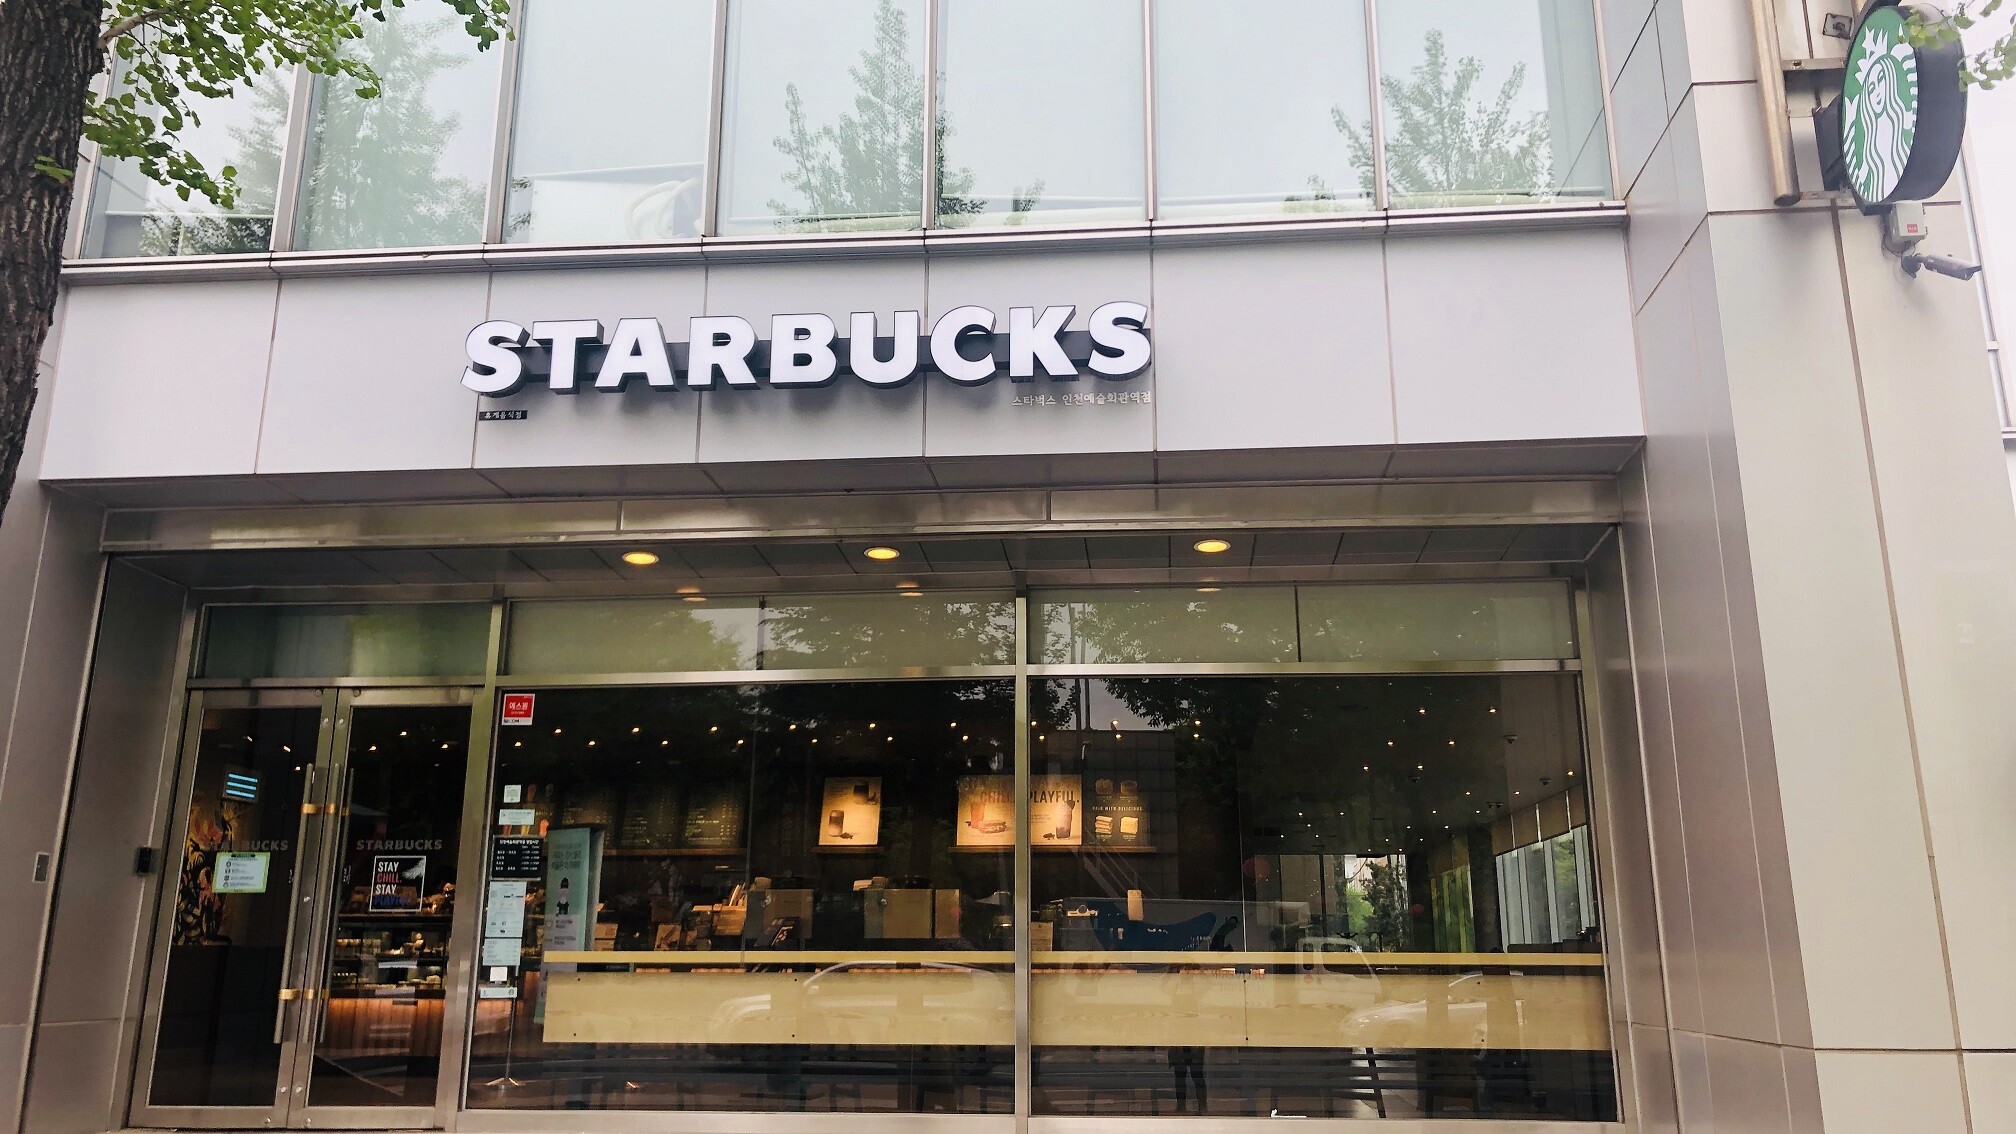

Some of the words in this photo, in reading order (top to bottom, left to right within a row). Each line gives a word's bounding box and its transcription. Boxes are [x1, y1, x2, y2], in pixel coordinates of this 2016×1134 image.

[460, 301, 1151, 395] STARBUCKS
[1011, 394, 1057, 407] 스타벅스
[1061, 390, 1151, 406] 인천예술회관역점
[356, 839, 443, 851] STARBUCKS
[378, 861, 400, 873] STAY
[375, 884, 398, 896] STAY
